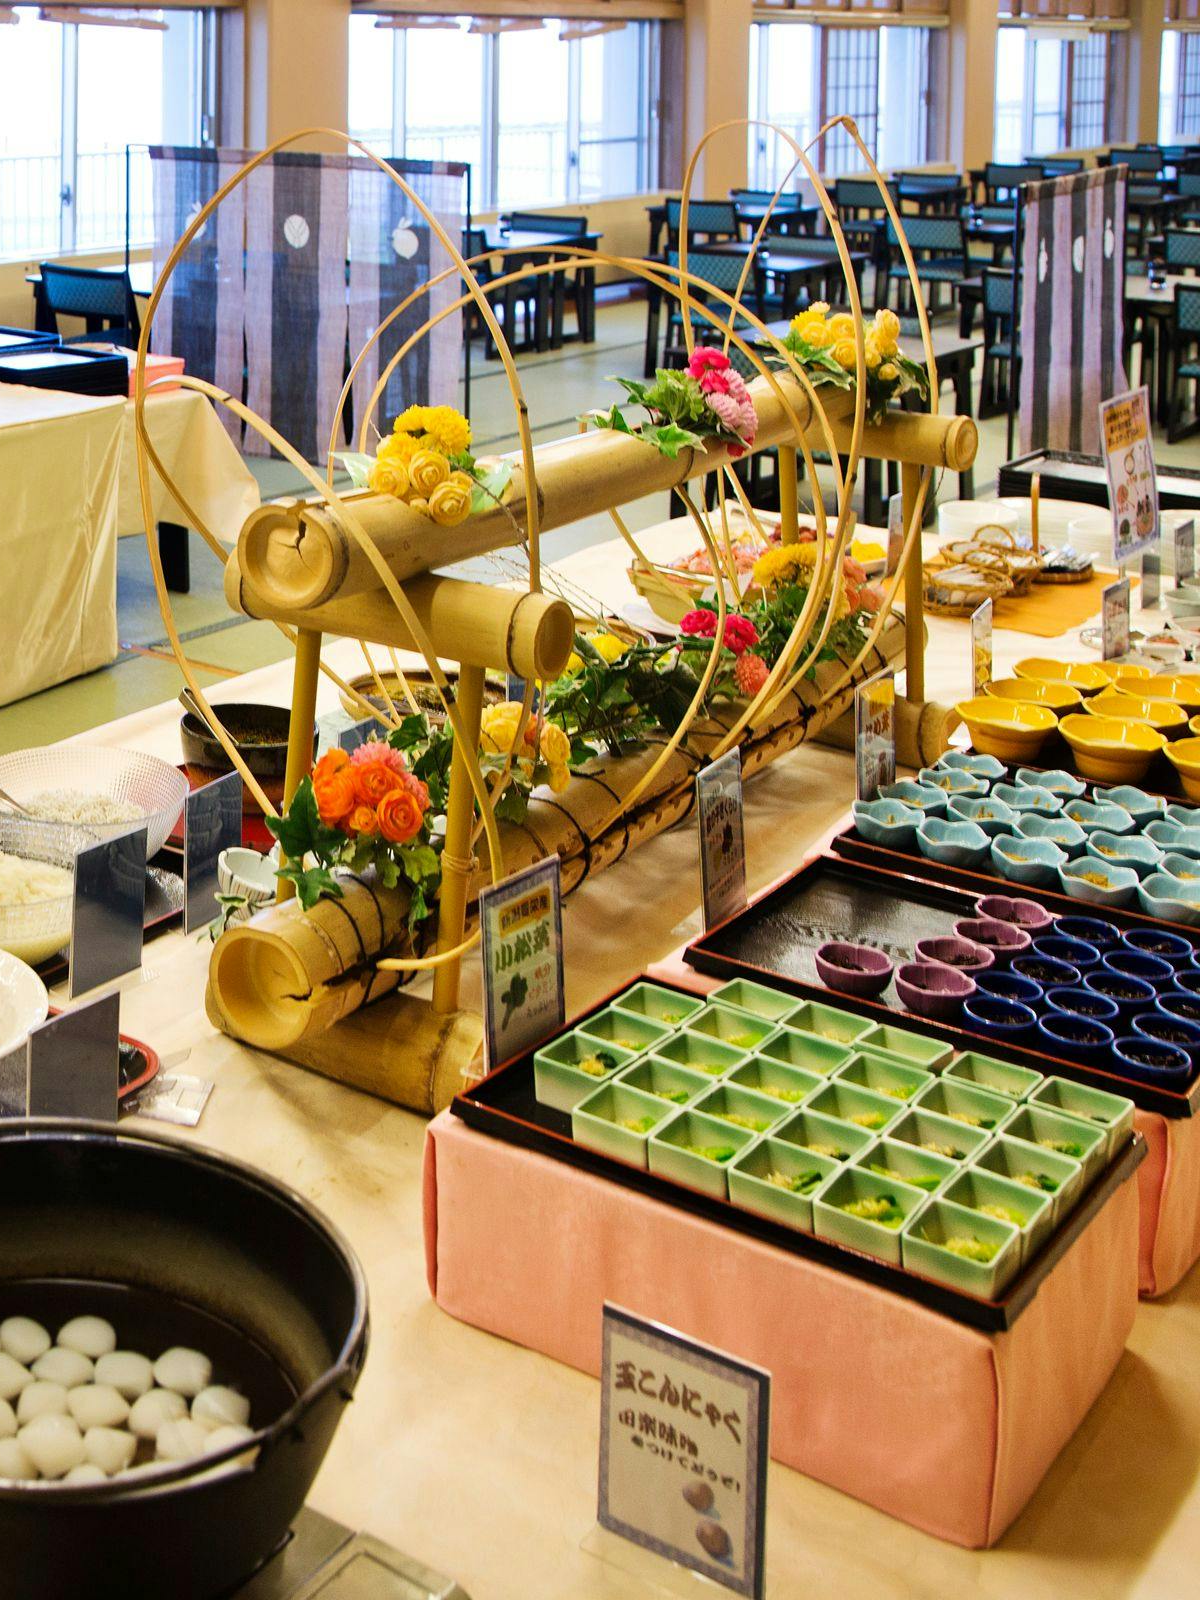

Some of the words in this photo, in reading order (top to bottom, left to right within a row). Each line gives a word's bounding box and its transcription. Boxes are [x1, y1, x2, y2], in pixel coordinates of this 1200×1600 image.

[615, 1359, 742, 1445] 玉こんにゃく
